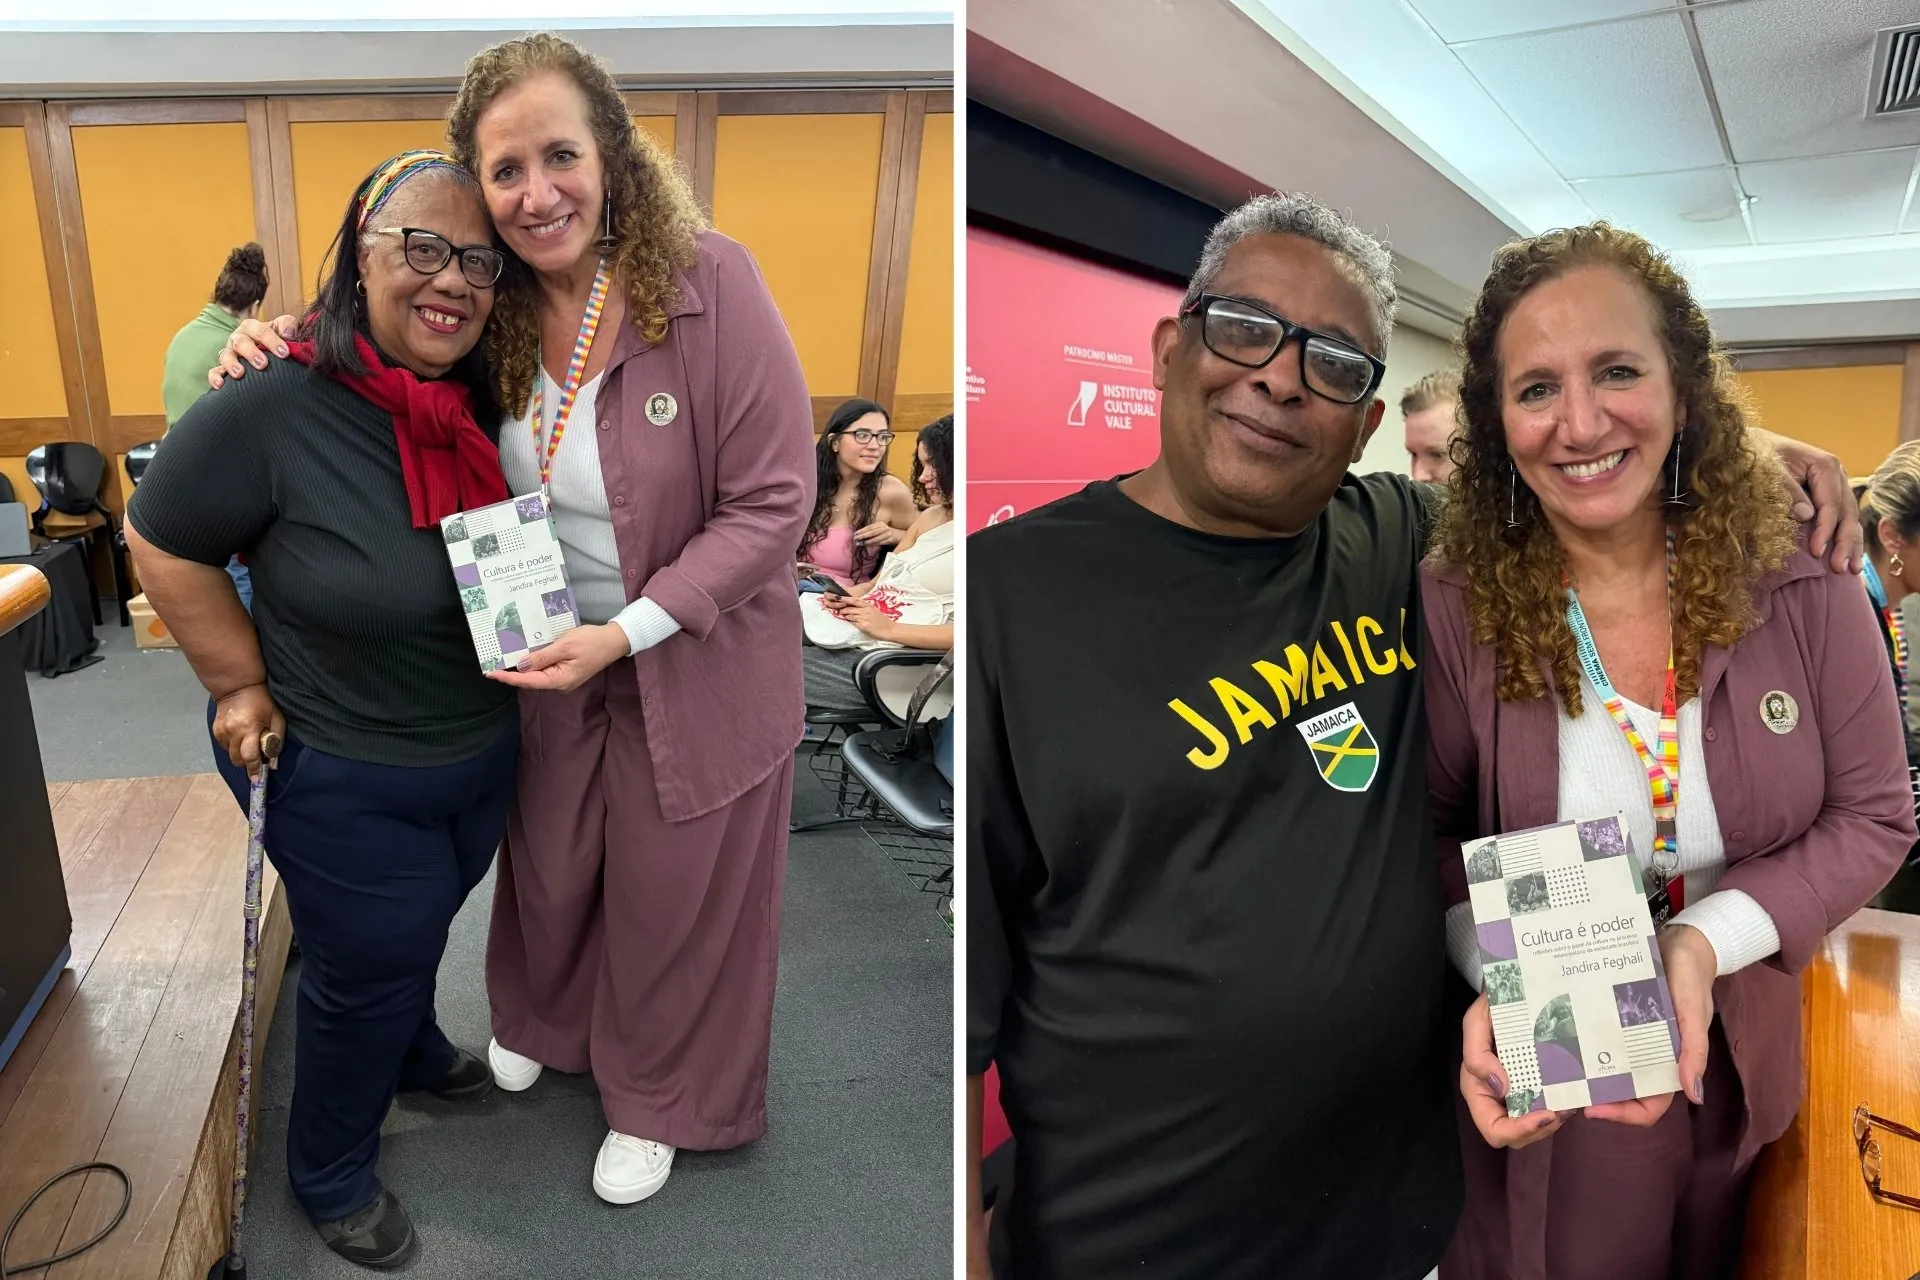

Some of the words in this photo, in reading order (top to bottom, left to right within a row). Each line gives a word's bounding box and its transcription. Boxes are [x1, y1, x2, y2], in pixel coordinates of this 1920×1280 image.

[1103, 384, 1156, 402] INSTITUTO
[1104, 399, 1156, 416] CULTURAL
[1105, 415, 1132, 430] VALE
[483, 564, 516, 578] Cultura
[518, 560, 524, 569] é
[526, 554, 553, 569] poder
[509, 581, 534, 593] Jandira
[535, 573, 559, 586] Feghali
[1585, 641, 1596, 658] SEM
[1591, 658, 1609, 687] CINEMA
[1306, 708, 1357, 738] JAMAICA
[1521, 928, 1573, 947] Cultura
[1577, 921, 1586, 938] é
[1590, 915, 1635, 939] poder
[1561, 960, 1600, 977] Jandira
[1602, 951, 1644, 970] Feghali
